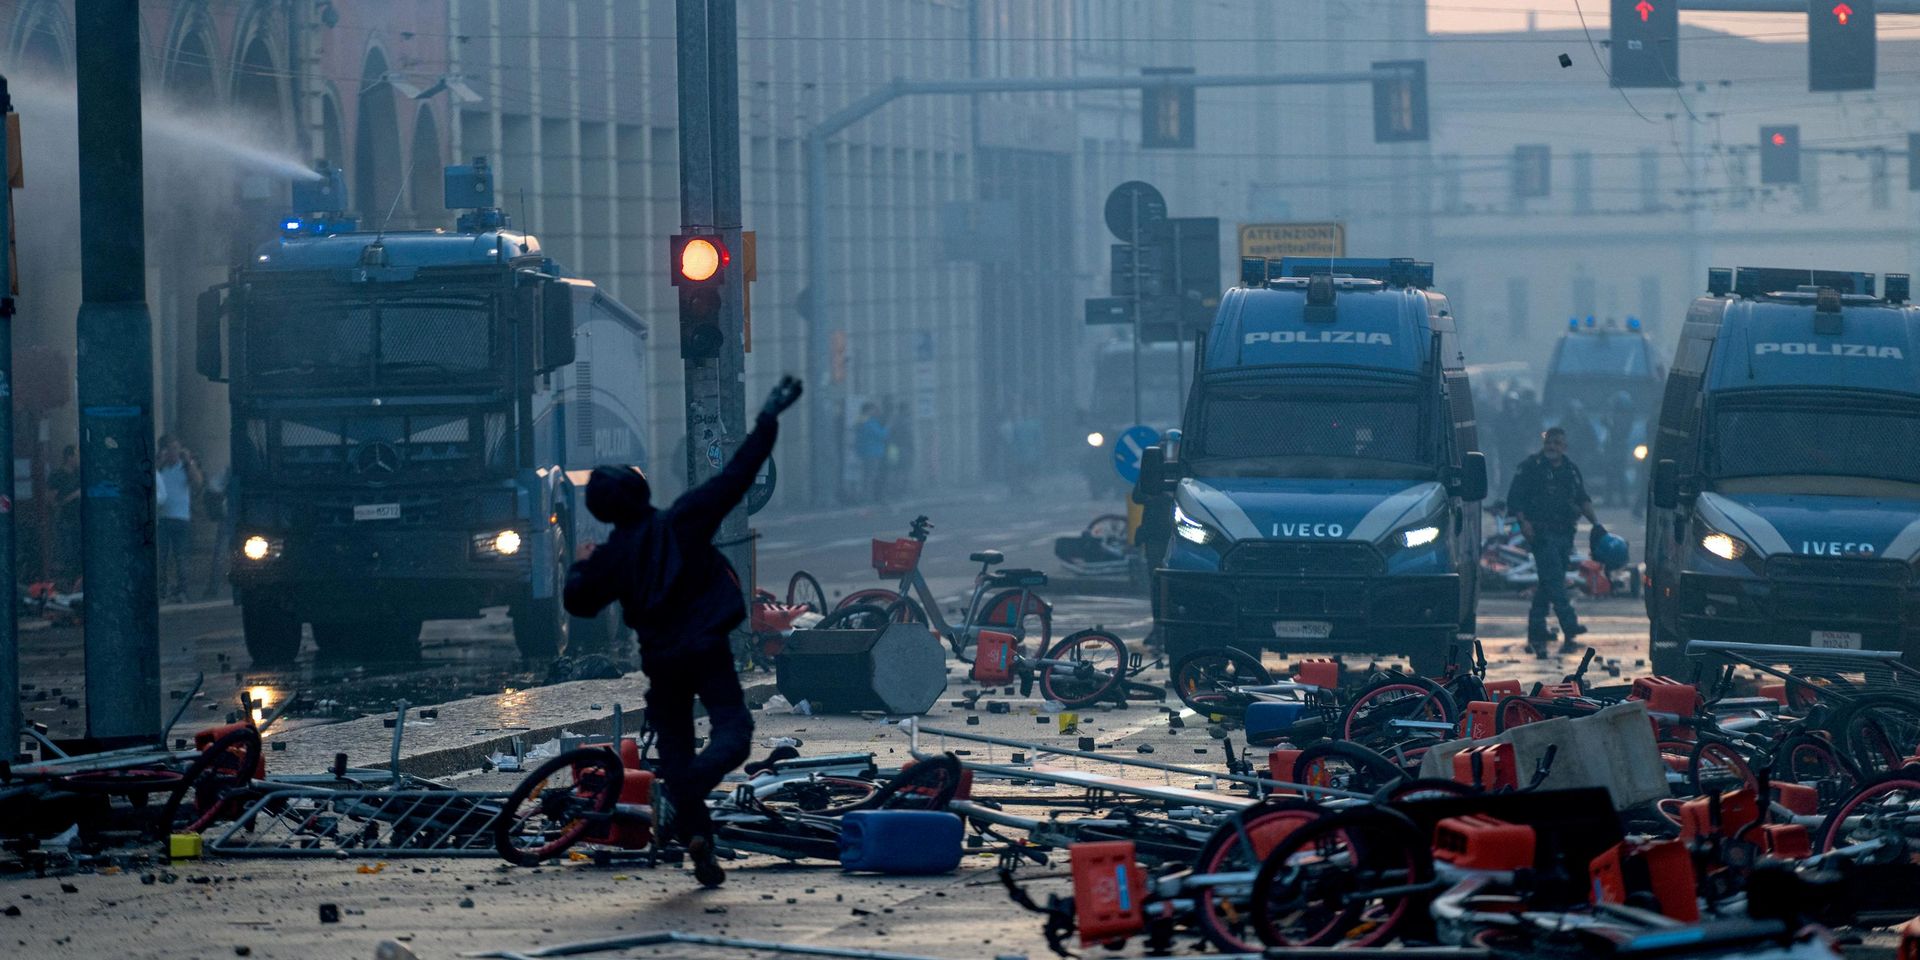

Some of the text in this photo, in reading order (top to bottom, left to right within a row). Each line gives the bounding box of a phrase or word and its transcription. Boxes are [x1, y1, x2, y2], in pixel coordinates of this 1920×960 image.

[360, 270, 367, 281] 2
[1244, 330, 1392, 346] POLIZIA
[1754, 342, 1904, 360] POLIZIA
[594, 428, 631, 459] POLIZIA
[1272, 523, 1343, 537] IVECO
[1803, 541, 1875, 557] IVECO
